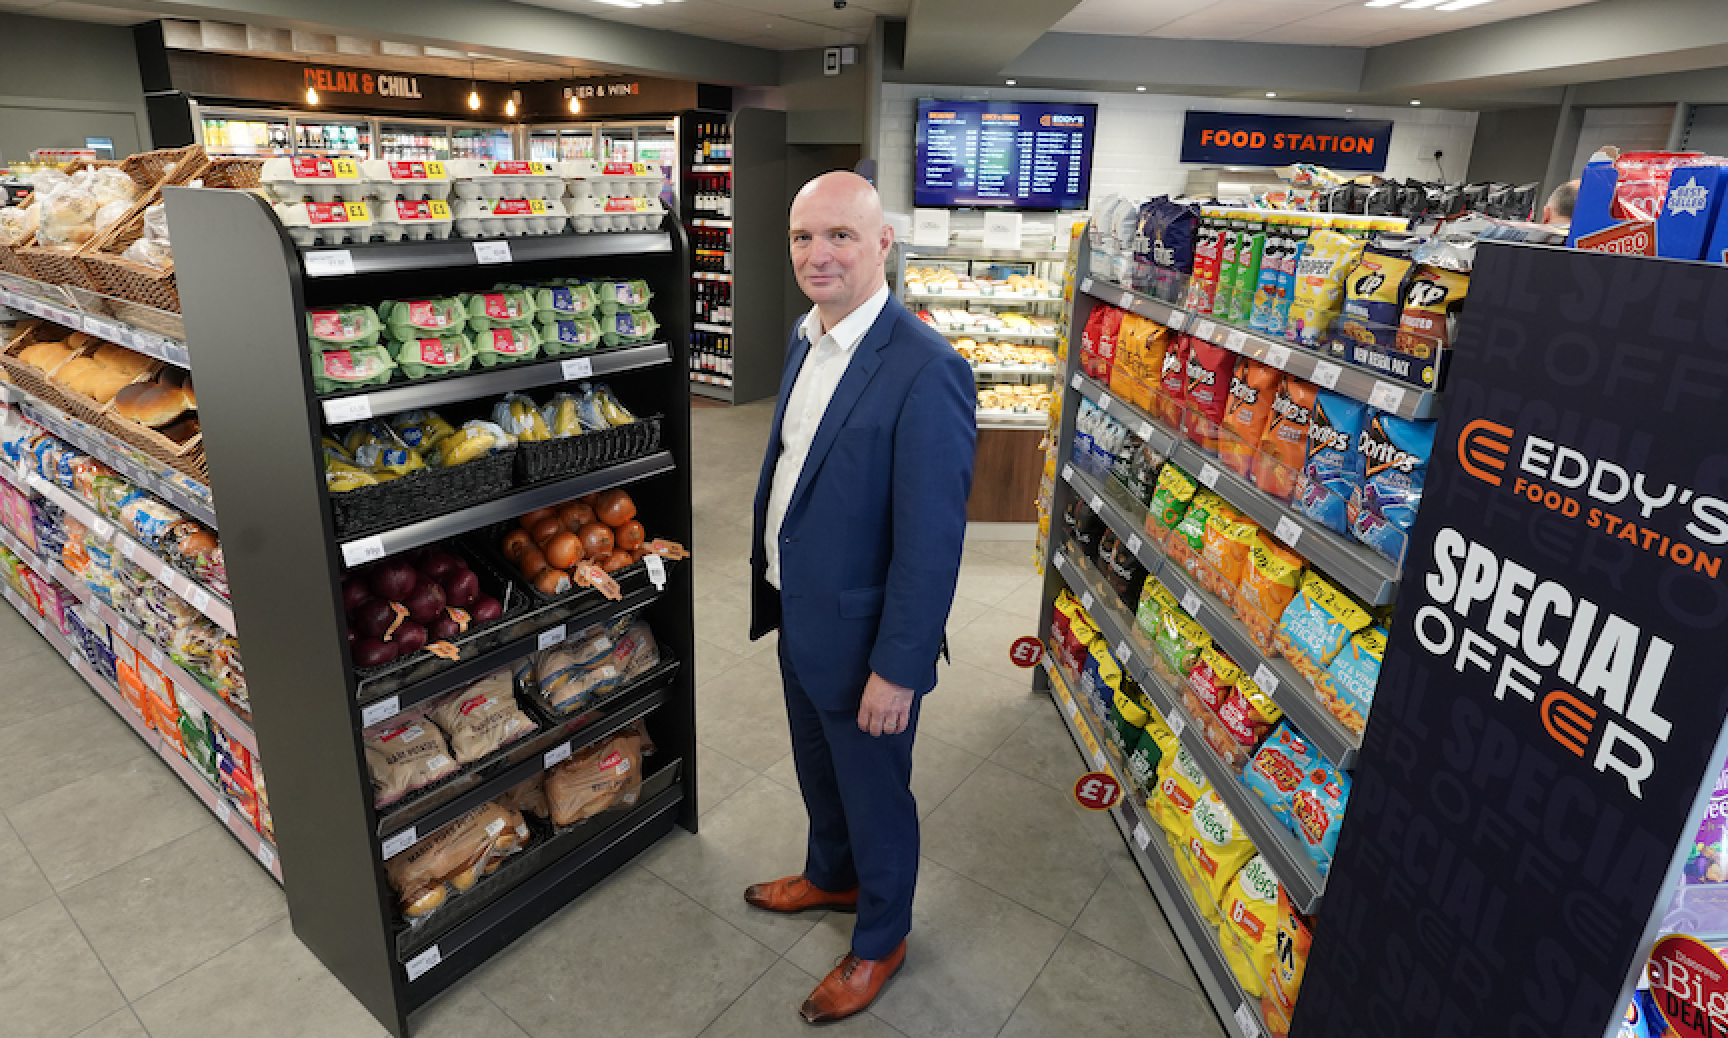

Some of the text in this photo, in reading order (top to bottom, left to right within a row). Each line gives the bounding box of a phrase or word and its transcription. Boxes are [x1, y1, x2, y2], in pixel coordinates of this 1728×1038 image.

[377, 75, 422, 98] CHILL
[563, 85, 594, 98] BER
[1201, 129, 1375, 155] FOOD STATION
[1597, 231, 1649, 257] RIBO
[1407, 280, 1445, 306] KP
[1358, 430, 1424, 473] Doritos
[1519, 434, 1728, 546] EDDY'S
[1513, 477, 1581, 518] FOOD
[1587, 507, 1723, 579] STATION
[1425, 527, 1674, 742] SPECIAL
[1013, 641, 1042, 663] £1
[1413, 605, 1655, 800] OFFER
[1079, 779, 1117, 805] £1
